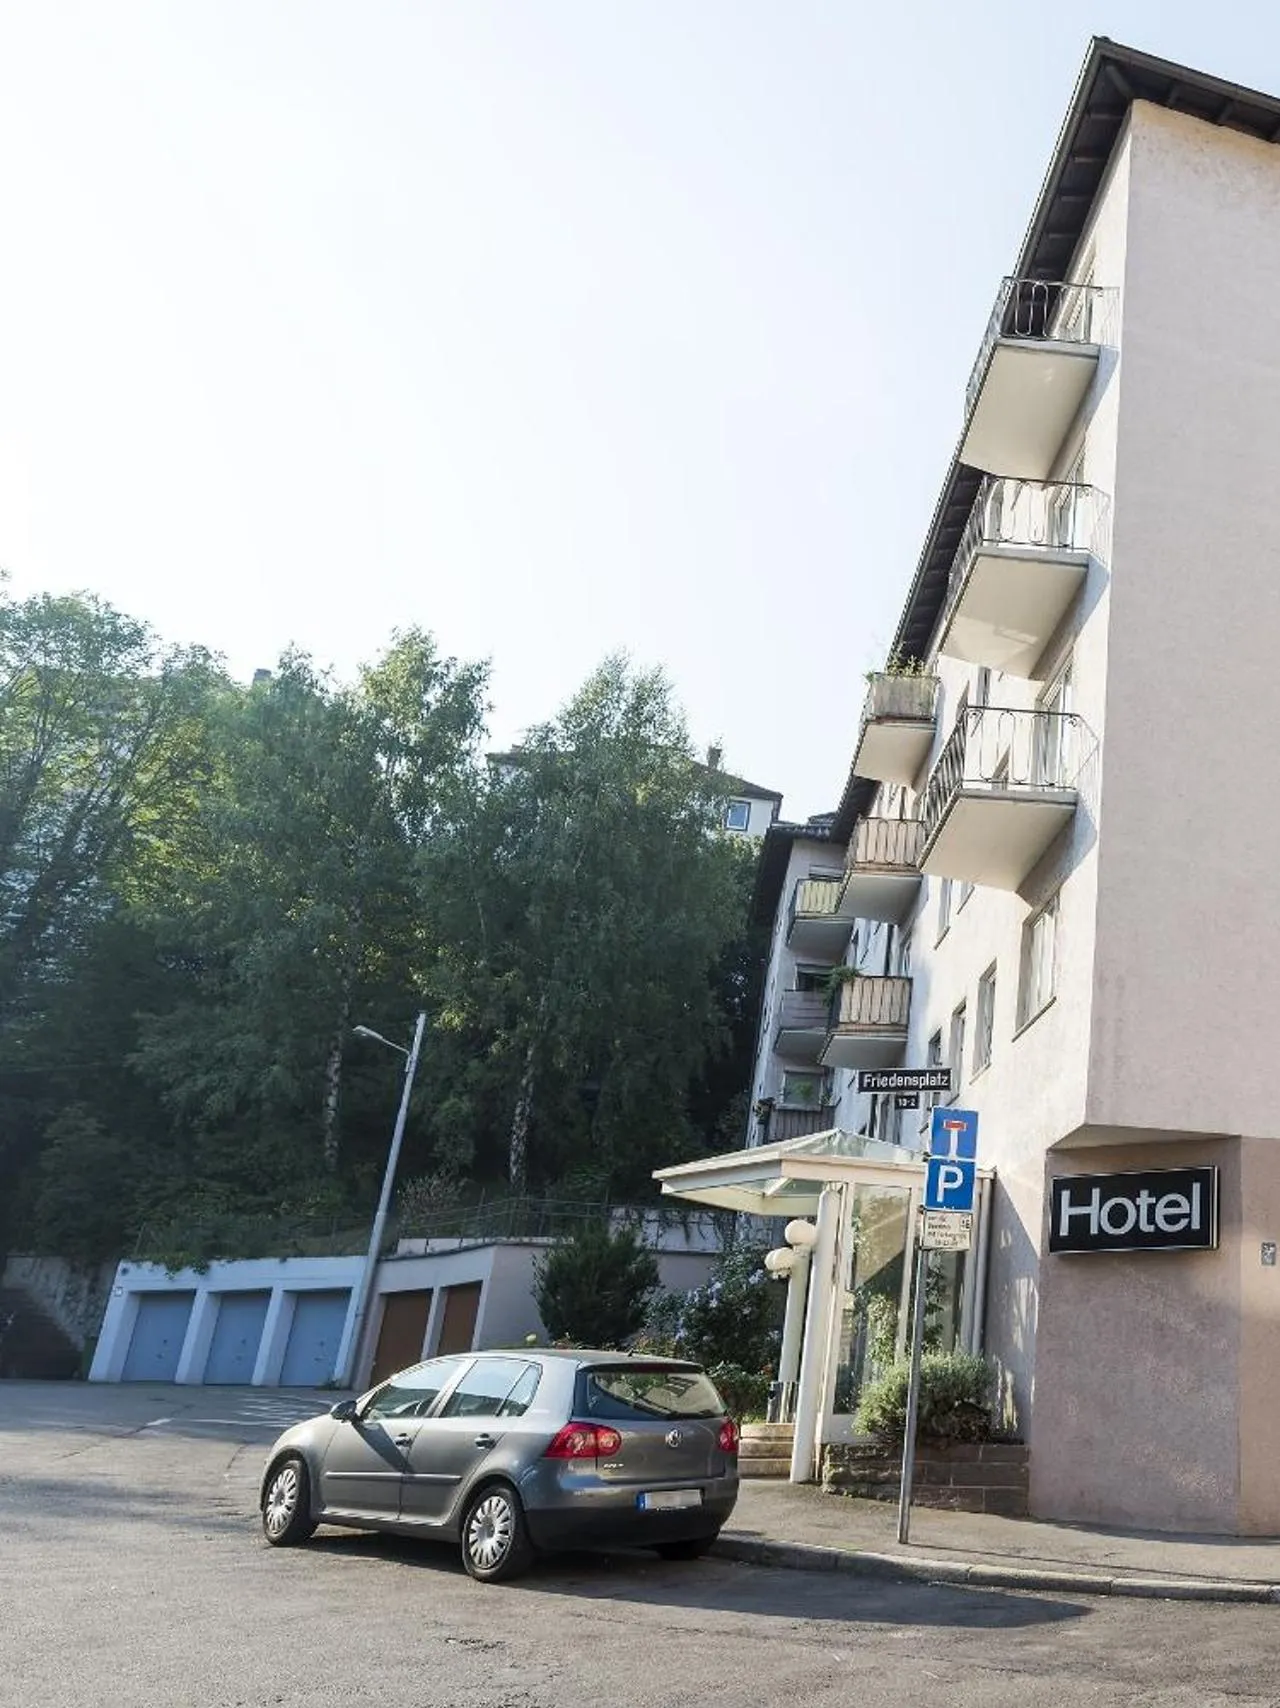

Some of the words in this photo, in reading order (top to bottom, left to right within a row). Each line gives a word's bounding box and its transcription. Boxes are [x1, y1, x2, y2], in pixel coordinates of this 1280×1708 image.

[863, 1072, 949, 1088] Friedensplatz
[937, 1166, 964, 1203] P
[1059, 1182, 1200, 1236] Hotel
